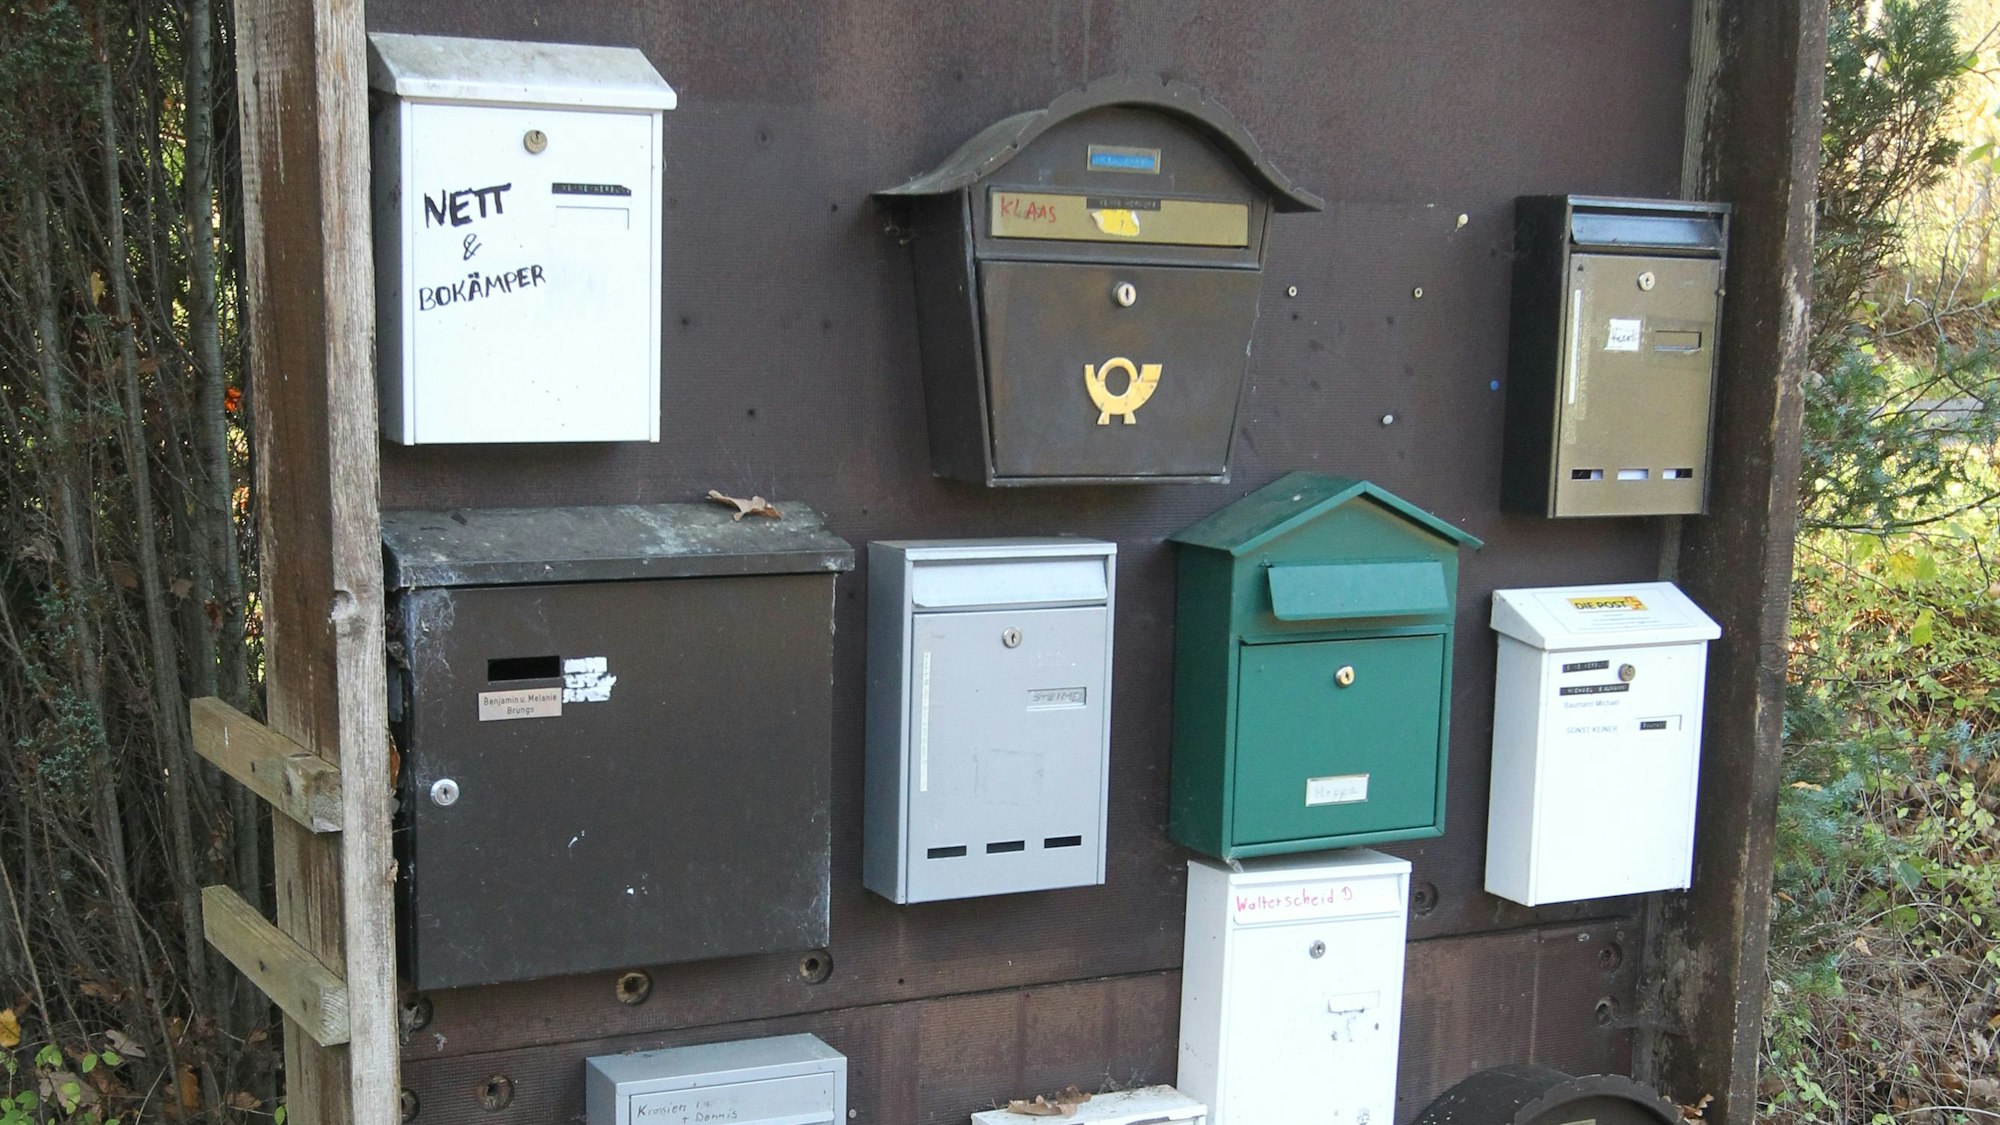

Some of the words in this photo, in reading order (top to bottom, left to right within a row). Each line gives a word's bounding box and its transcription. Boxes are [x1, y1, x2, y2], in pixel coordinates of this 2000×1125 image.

[424, 182, 512, 229] NETT
[1000, 196, 1057, 223] KLAAS
[463, 233, 482, 261] &
[419, 264, 546, 311] BOKÄMPER
[1575, 601, 1596, 610] DIE
[1597, 600, 1628, 609] POST
[483, 695, 519, 706] Benjamin
[528, 693, 557, 703] Melanie
[507, 706, 535, 716] Brungs
[1236, 887, 1334, 912] Walterscheid
